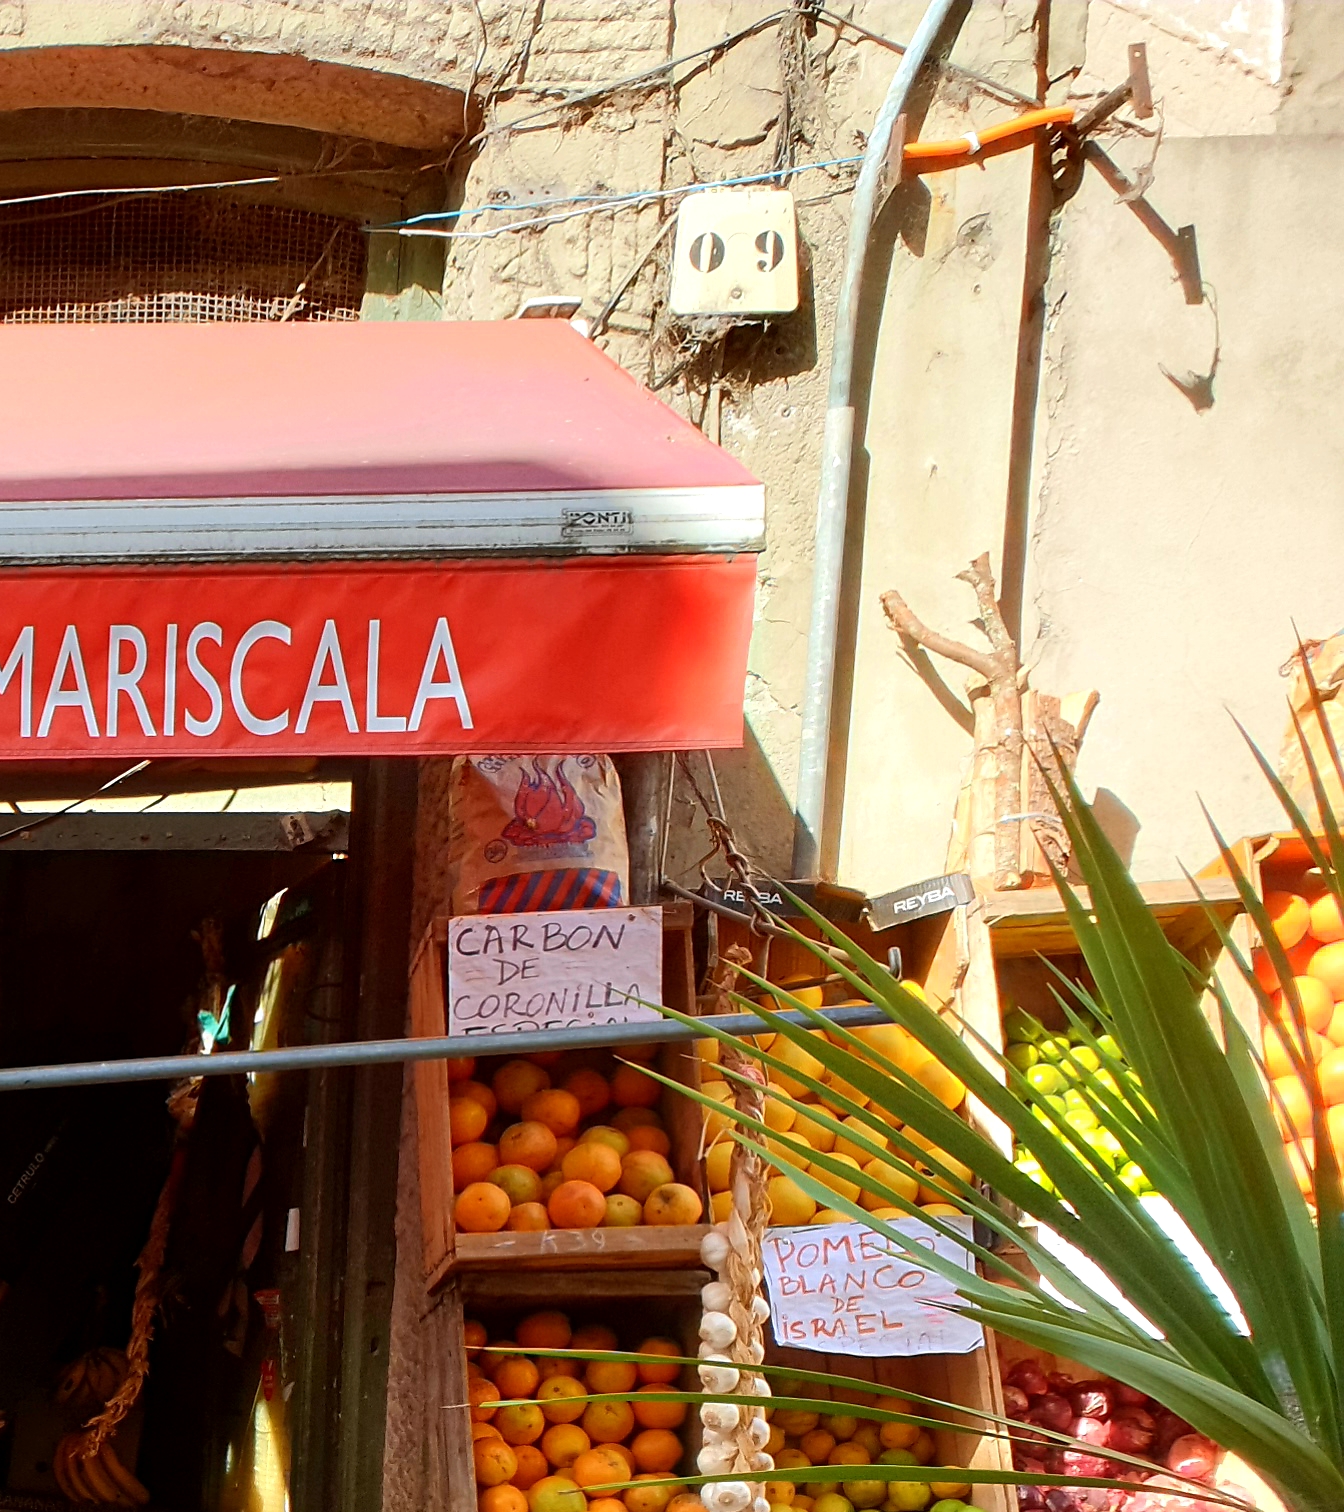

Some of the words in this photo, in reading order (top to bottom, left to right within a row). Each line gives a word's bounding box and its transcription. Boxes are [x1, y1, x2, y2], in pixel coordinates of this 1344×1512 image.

[723, 889, 784, 905] REBA
[893, 886, 956, 914] REYBA
[456, 922, 626, 956] CARBON
[492, 957, 541, 986] DE
[778, 1264, 926, 1297] BLANCO
[830, 1295, 865, 1315] DE
